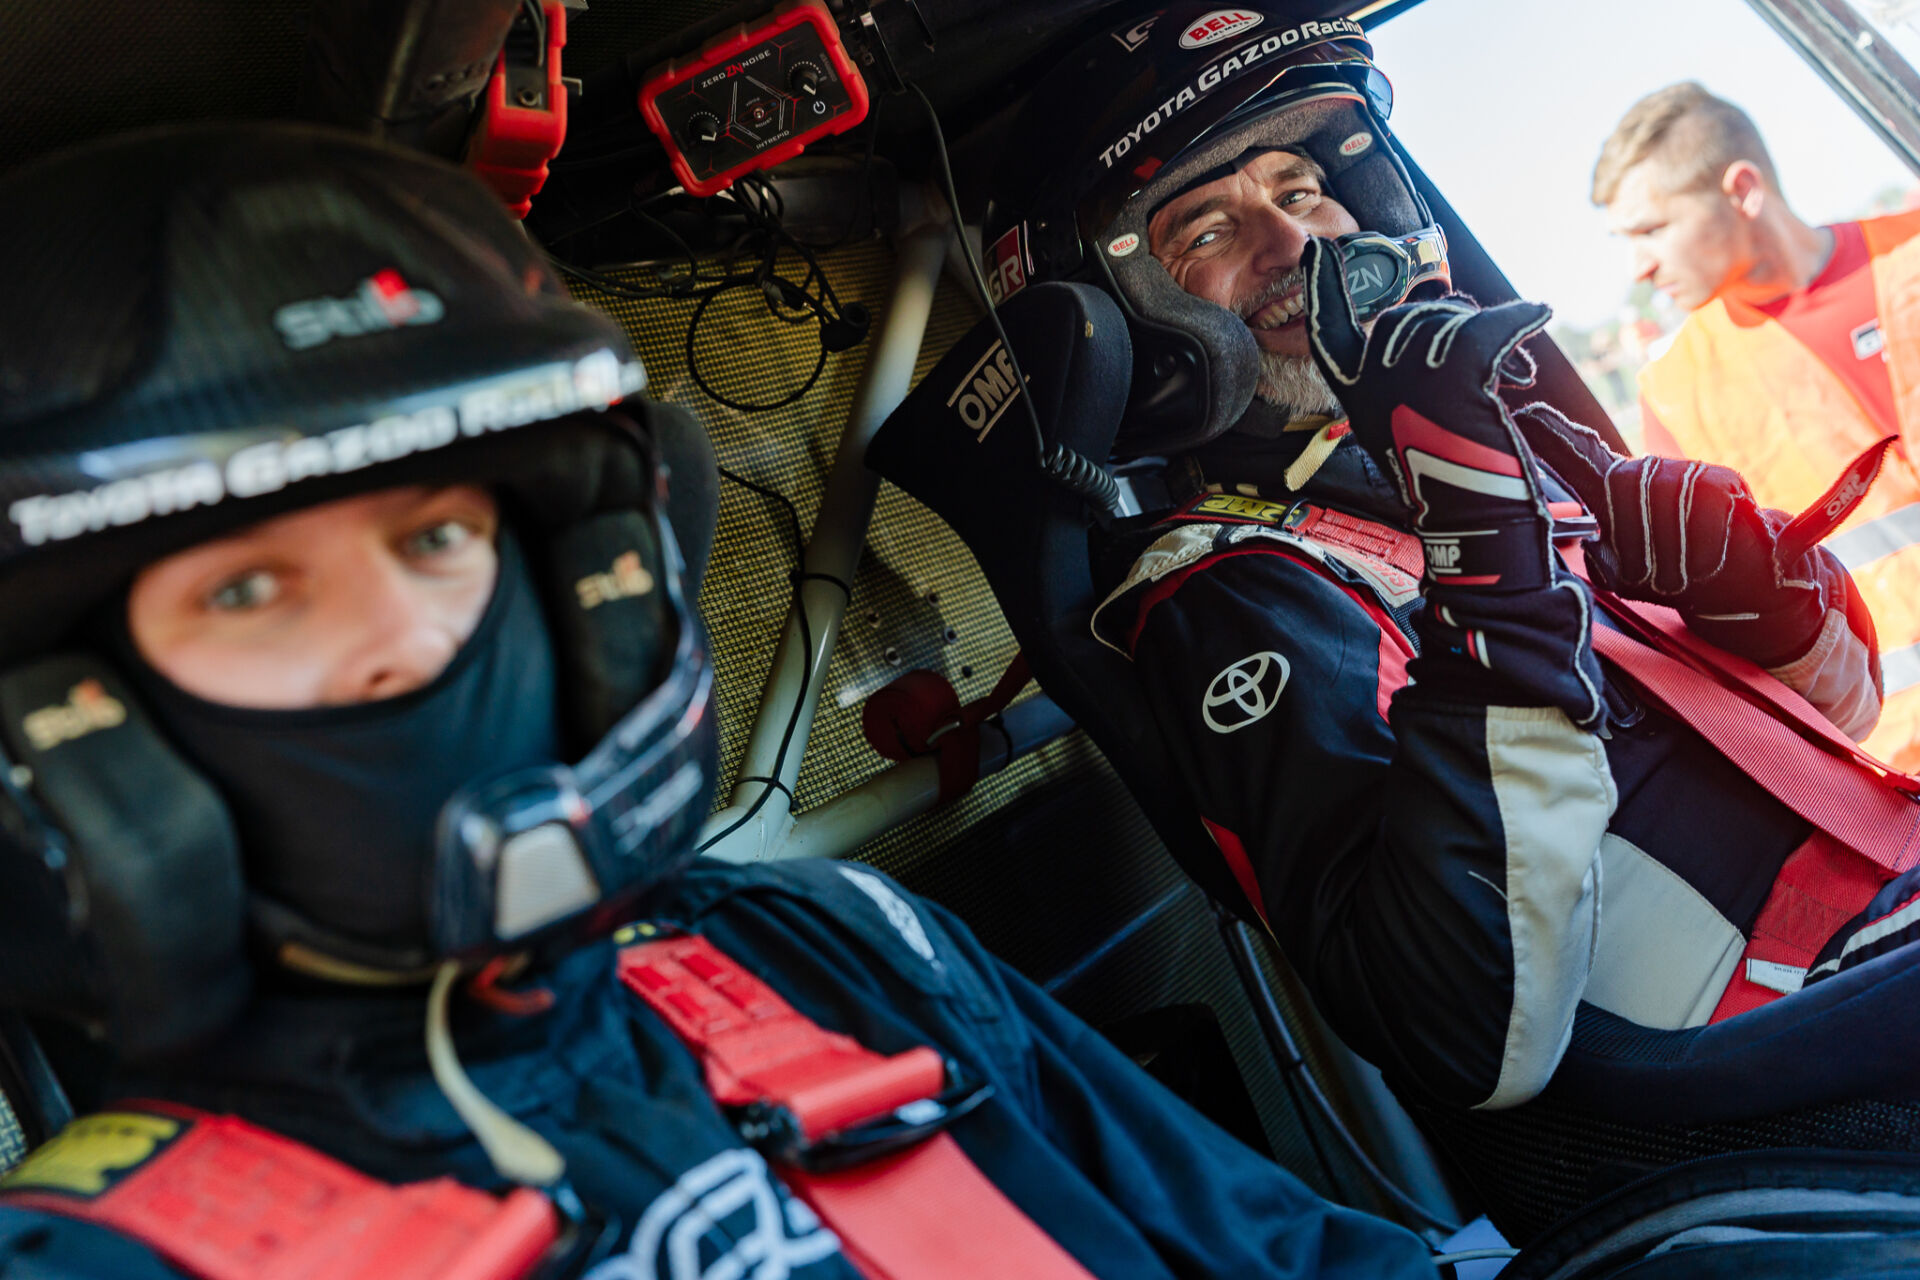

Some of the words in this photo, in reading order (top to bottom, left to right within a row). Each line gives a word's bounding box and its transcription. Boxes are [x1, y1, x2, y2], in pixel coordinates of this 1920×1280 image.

[1188, 12, 1254, 42] BELL
[701, 72, 726, 89] ZERO
[741, 49, 772, 69] NOISE
[1099, 86, 1196, 169] TOYOTA
[1198, 28, 1299, 93] GAZOO
[755, 129, 791, 151] INTREPID
[1343, 136, 1371, 153] BELL
[1111, 236, 1137, 253] BELL
[1425, 544, 1461, 568] OMP
